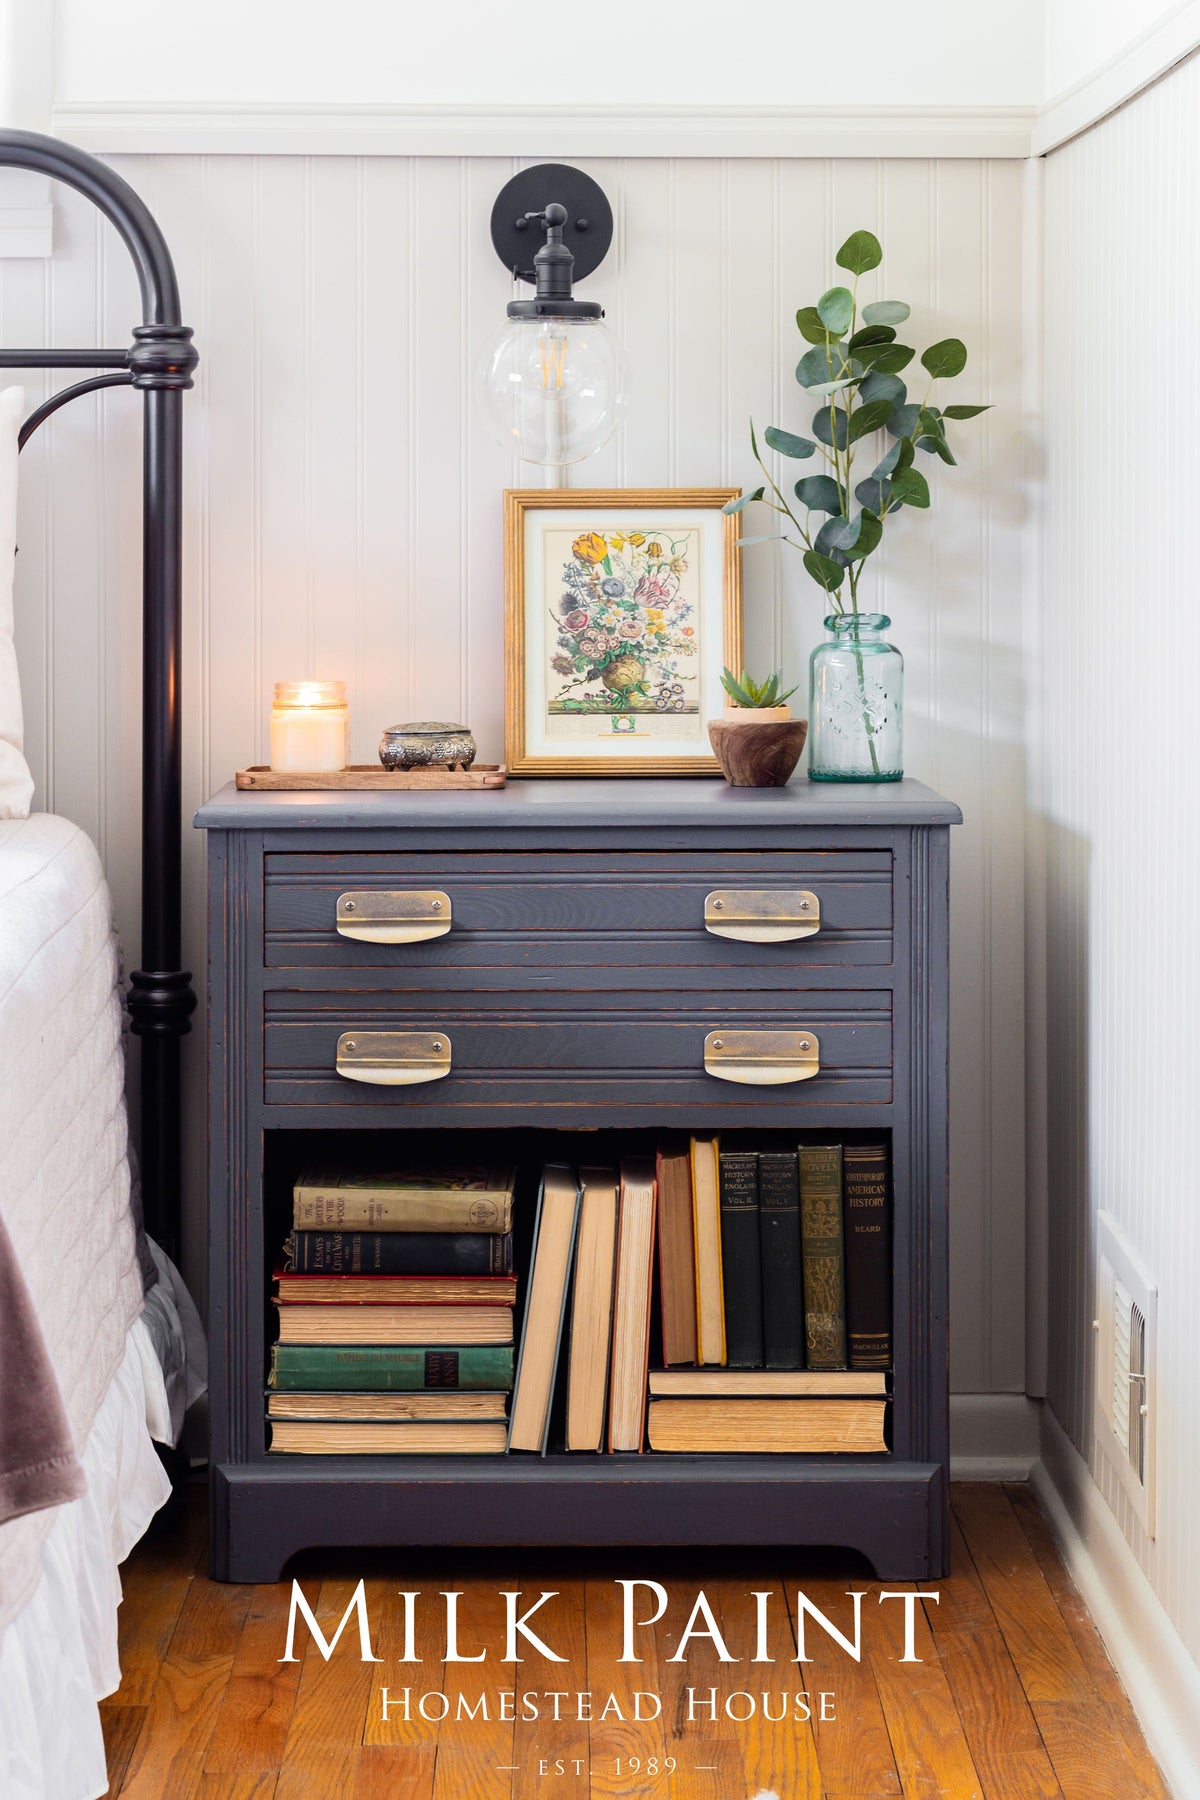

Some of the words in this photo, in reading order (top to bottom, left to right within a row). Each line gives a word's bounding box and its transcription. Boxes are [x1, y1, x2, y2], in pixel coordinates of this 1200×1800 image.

[801, 1163, 838, 1172] NOVELS
[847, 1185, 886, 1195] AMERICAN
[326, 1199, 335, 1212] THE
[337, 1197, 345, 1226] WOODS
[849, 1197, 885, 1208] HISTORY
[855, 1225, 881, 1233] BEARD
[332, 1233, 343, 1251] WAR
[314, 1237, 324, 1268] ESSAYS
[333, 1251, 343, 1272] CIVIL
[428, 1352, 440, 1385] MARY
[443, 1354, 455, 1385] ANNE
